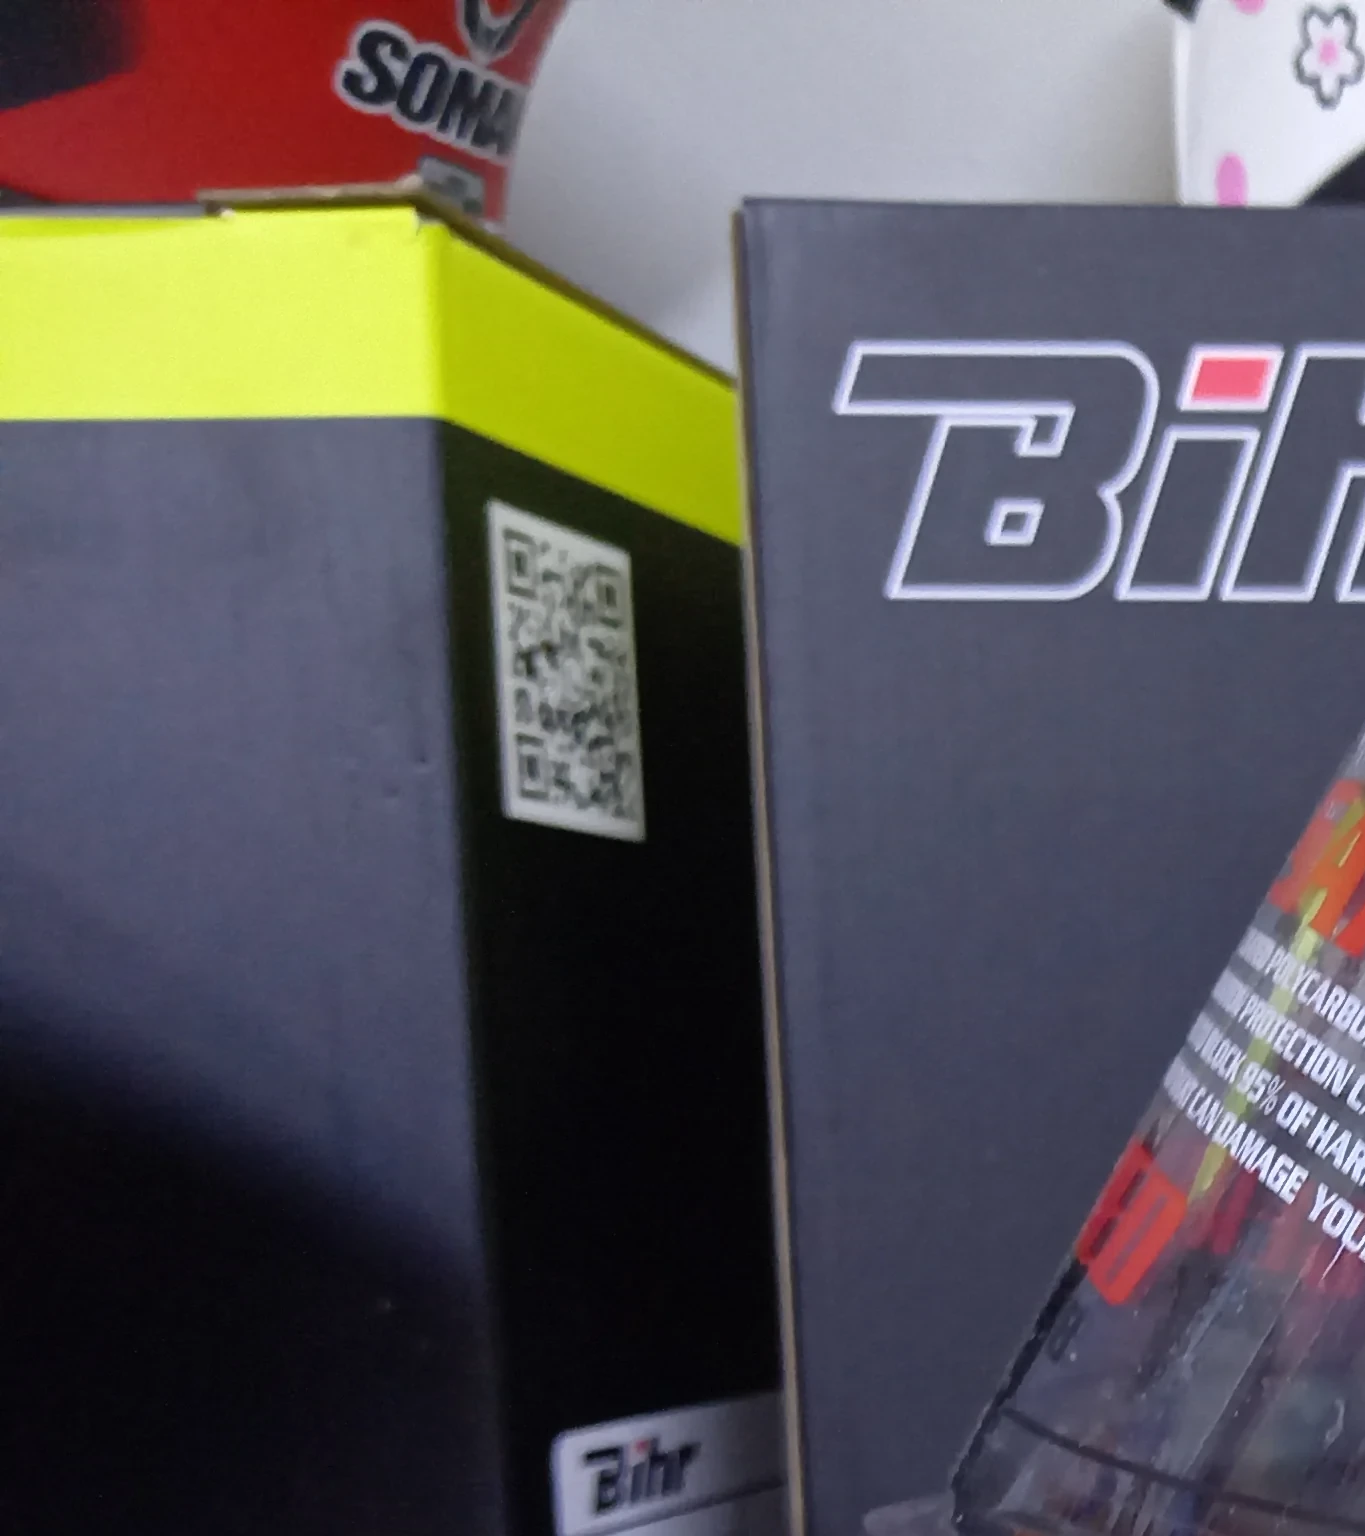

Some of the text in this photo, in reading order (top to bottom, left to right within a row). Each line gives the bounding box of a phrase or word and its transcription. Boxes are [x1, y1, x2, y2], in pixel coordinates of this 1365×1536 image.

[1238, 993, 1356, 1098] PROTECTION
[1235, 1061, 1286, 1116] 95%
[1275, 1090, 1318, 1137] OF
[1186, 1086, 1225, 1136] CAN
[1212, 1111, 1309, 1205] DAMAGE
[583, 1436, 702, 1514] Bihr
